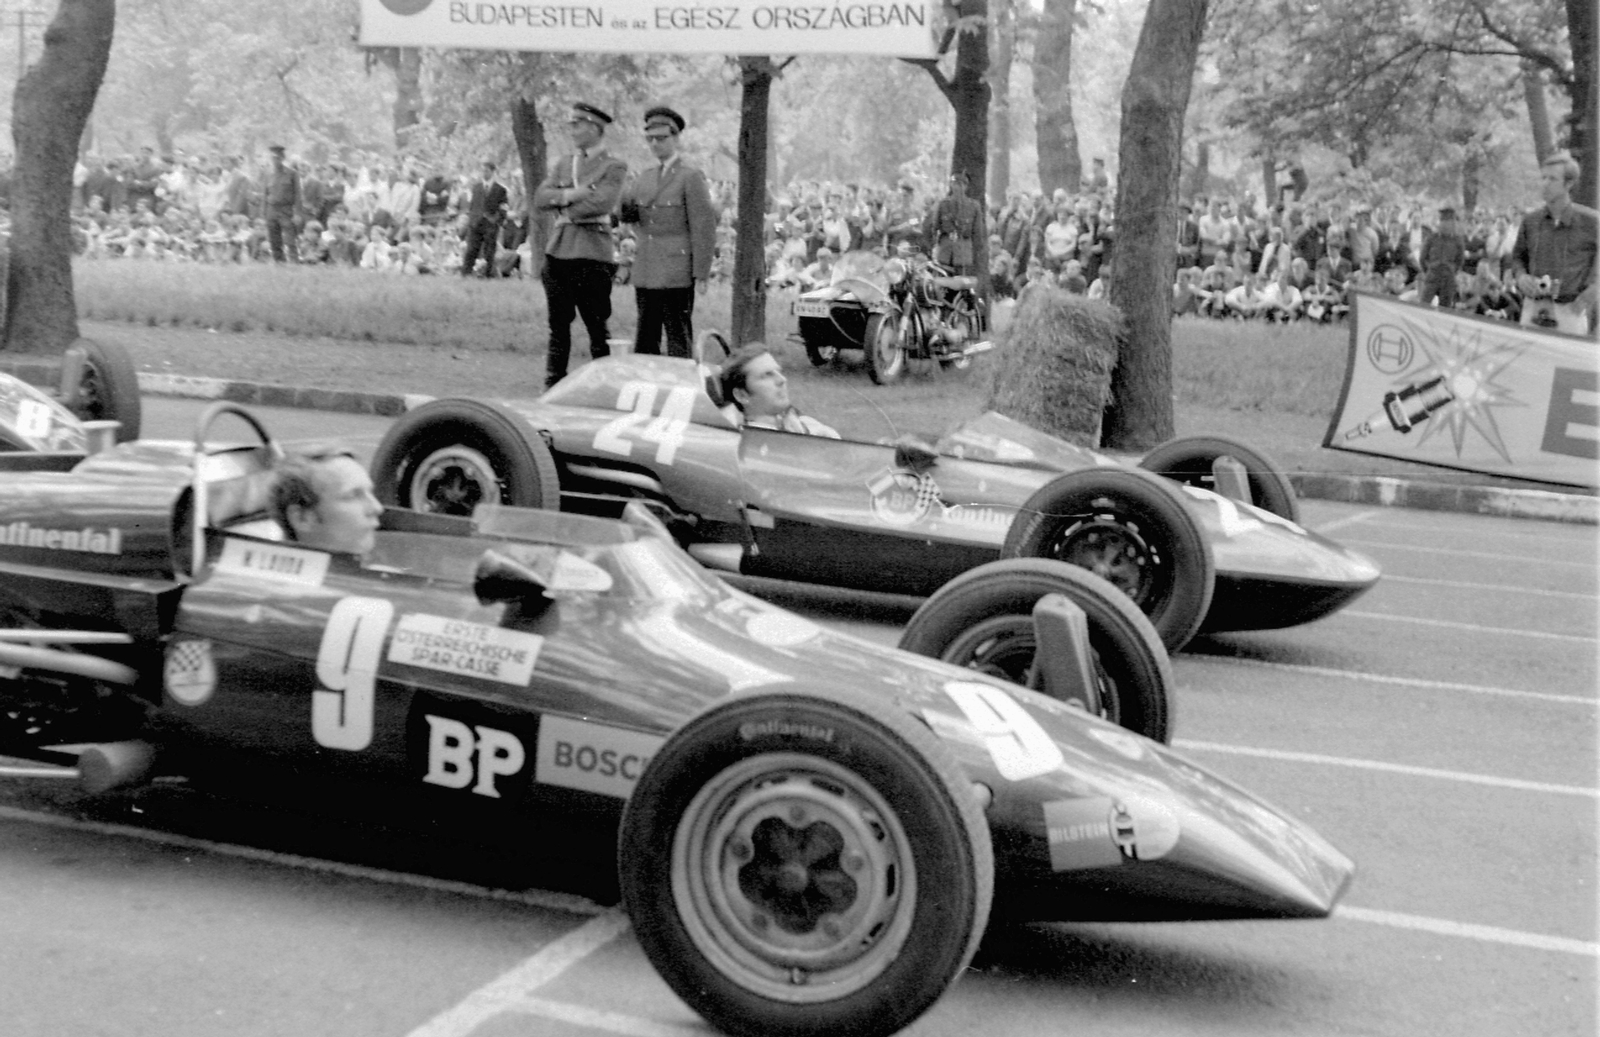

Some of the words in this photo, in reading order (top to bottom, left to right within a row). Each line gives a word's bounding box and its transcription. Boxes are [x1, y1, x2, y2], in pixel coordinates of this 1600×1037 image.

[450, 2, 603, 27] BUDAPESTEN
[655, 2, 741, 29] EGÉSZ
[752, 1, 925, 29] ORSZÁGBAN
[16, 400, 51, 438] 8
[593, 381, 697, 465] 24
[442, 622, 489, 641] ERSTE
[312, 596, 393, 750] 9
[422, 714, 525, 798] BP
[555, 741, 649, 781] BOSC
[943, 681, 1064, 782] 9
